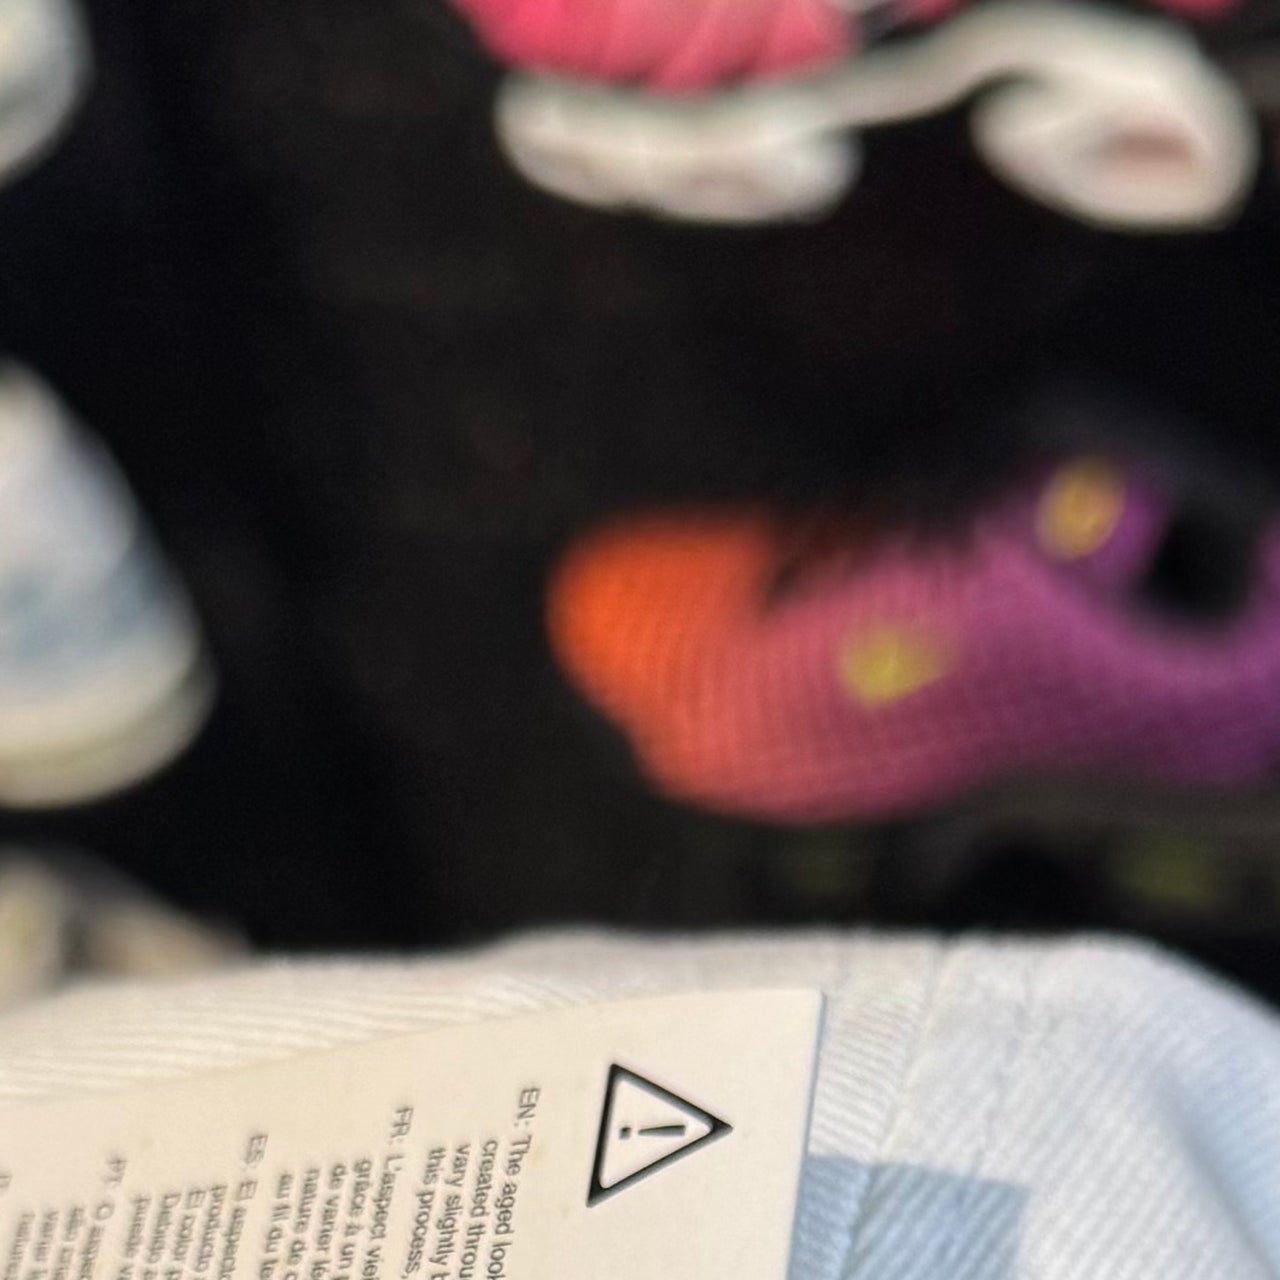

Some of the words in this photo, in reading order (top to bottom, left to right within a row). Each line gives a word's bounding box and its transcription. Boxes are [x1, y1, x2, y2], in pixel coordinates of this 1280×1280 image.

[421, 1145, 447, 1186] this
[443, 1141, 471, 1188] vary
[468, 1137, 499, 1218] created
[503, 1133, 532, 1176] The
[400, 1188, 435, 1279] process,
[427, 1192, 463, 1266] slightly
[492, 1181, 518, 1236] aged
